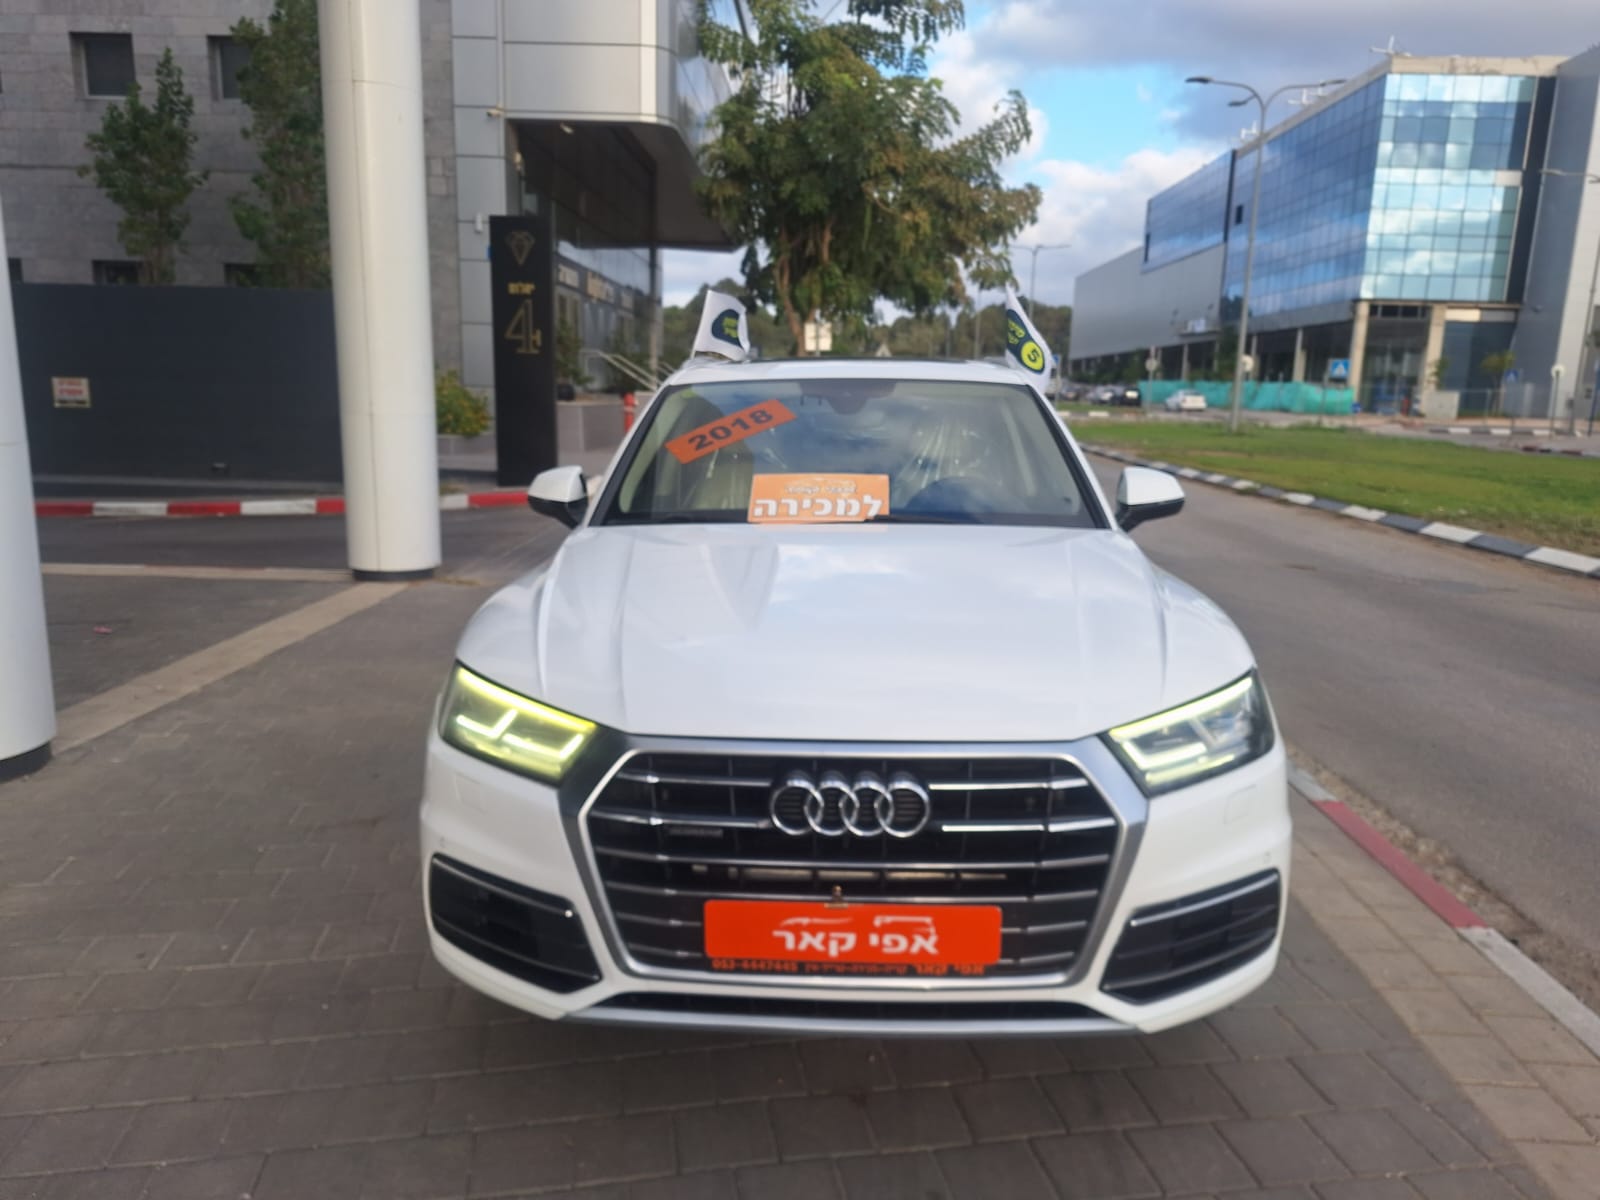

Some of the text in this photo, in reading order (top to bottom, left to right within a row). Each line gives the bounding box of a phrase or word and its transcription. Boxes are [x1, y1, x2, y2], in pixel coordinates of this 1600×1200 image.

[504, 299, 542, 355] 4
[688, 409, 773, 451] 2018
[753, 493, 882, 517] למכירה
[772, 929, 939, 958] אפי קאר
